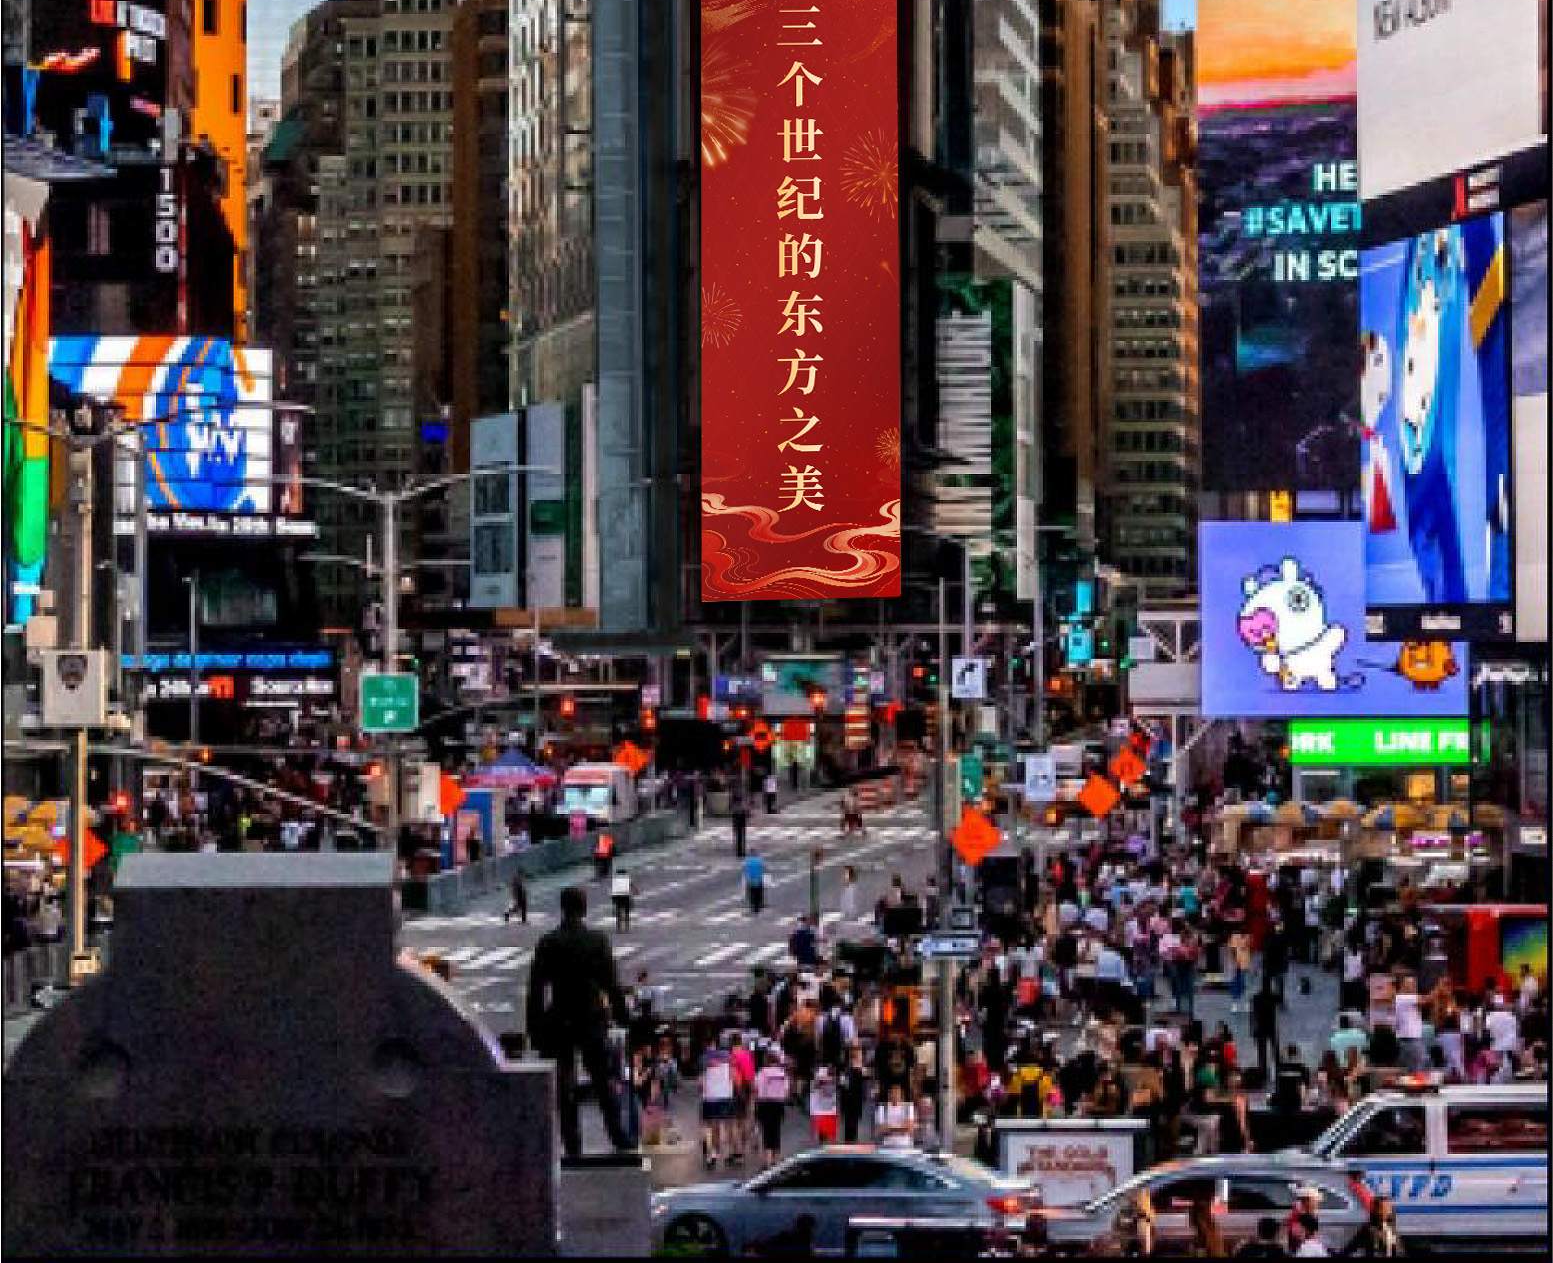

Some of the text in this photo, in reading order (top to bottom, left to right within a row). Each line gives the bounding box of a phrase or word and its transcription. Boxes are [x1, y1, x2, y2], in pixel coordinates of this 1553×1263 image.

[1313, 163, 1358, 191] HE
[156, 167, 178, 272] 1500
[1274, 249, 1358, 281] IN SC
